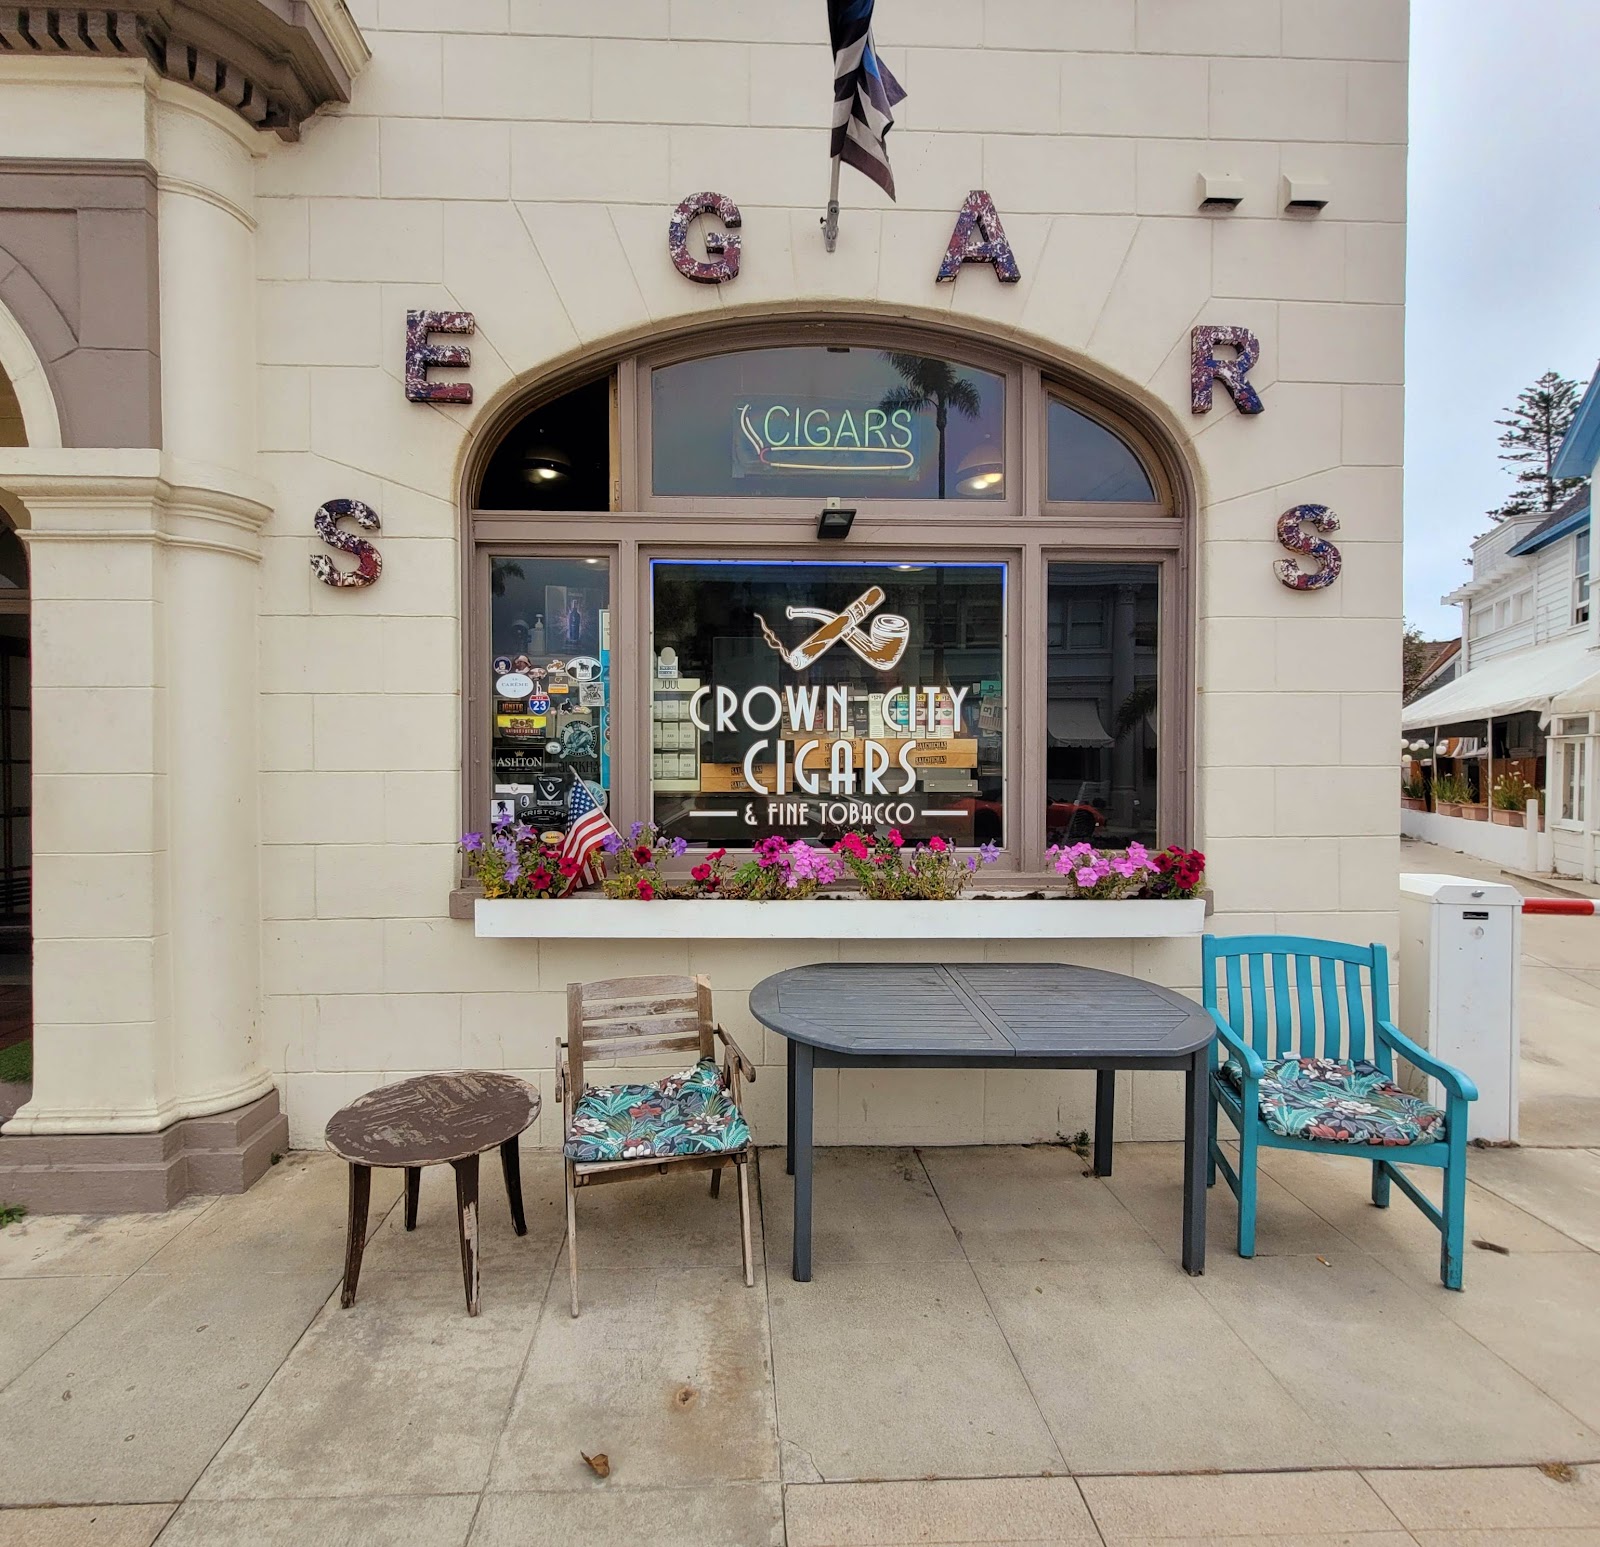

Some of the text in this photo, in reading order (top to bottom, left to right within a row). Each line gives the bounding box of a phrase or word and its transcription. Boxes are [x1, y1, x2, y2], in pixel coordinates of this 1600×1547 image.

[764, 405, 913, 449] CIGARS
[661, 680, 680, 690] JUUL
[533, 700, 547, 711] 23
[689, 685, 849, 732] CROWN
[881, 685, 970, 732] CITY
[496, 756, 543, 767] ASHTON
[743, 739, 918, 795] CIGARS
[744, 802, 915, 825] & FINE TOBACCO
